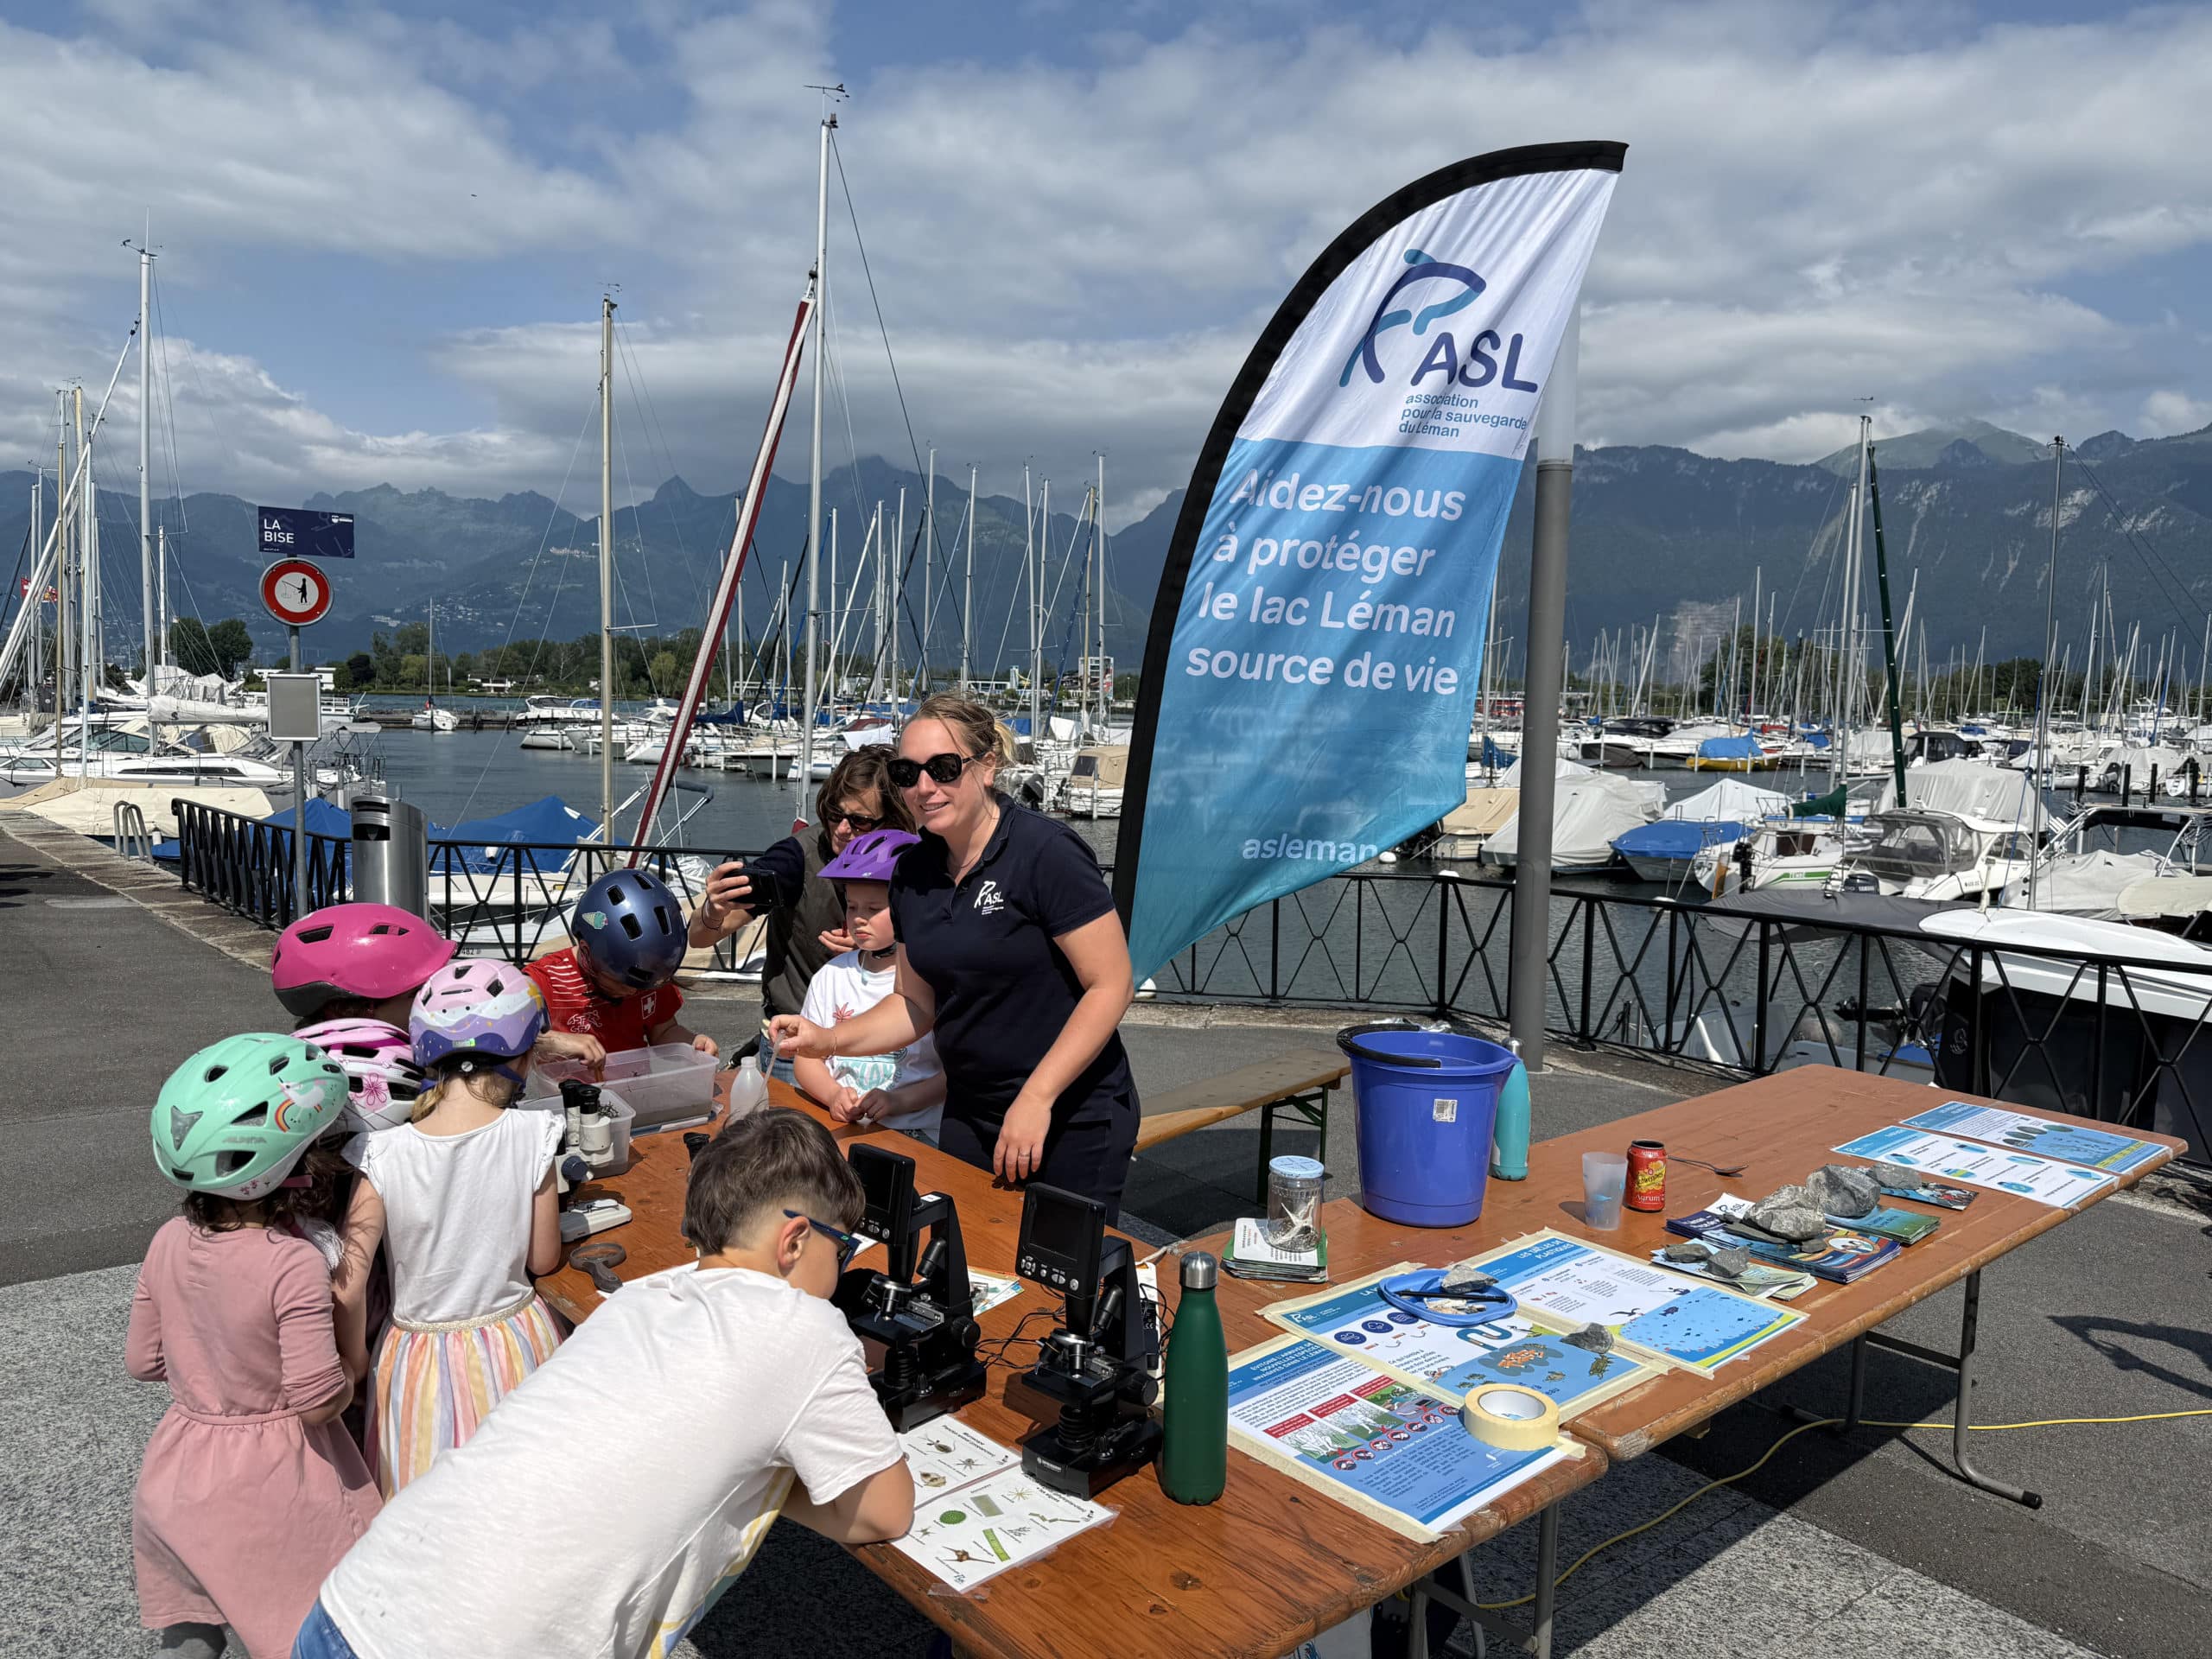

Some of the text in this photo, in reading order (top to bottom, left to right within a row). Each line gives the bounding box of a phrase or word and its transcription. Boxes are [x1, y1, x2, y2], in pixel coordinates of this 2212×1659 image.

[1410, 329, 1538, 393] ASL
[1405, 394, 1478, 409] association
[1402, 407, 1528, 430] pour la sauvegarde
[1399, 420, 1459, 438] du Léman
[1229, 468, 1466, 521] Aidez-nous
[264, 518, 281, 531] LA
[264, 531, 295, 543] BISE
[1212, 521, 1436, 584] à protéger
[1198, 581, 1456, 638] le lac Léman
[1185, 646, 1459, 695] source de vie
[984, 892, 1004, 906] ASL
[1636, 1193, 1661, 1202] Agrum
